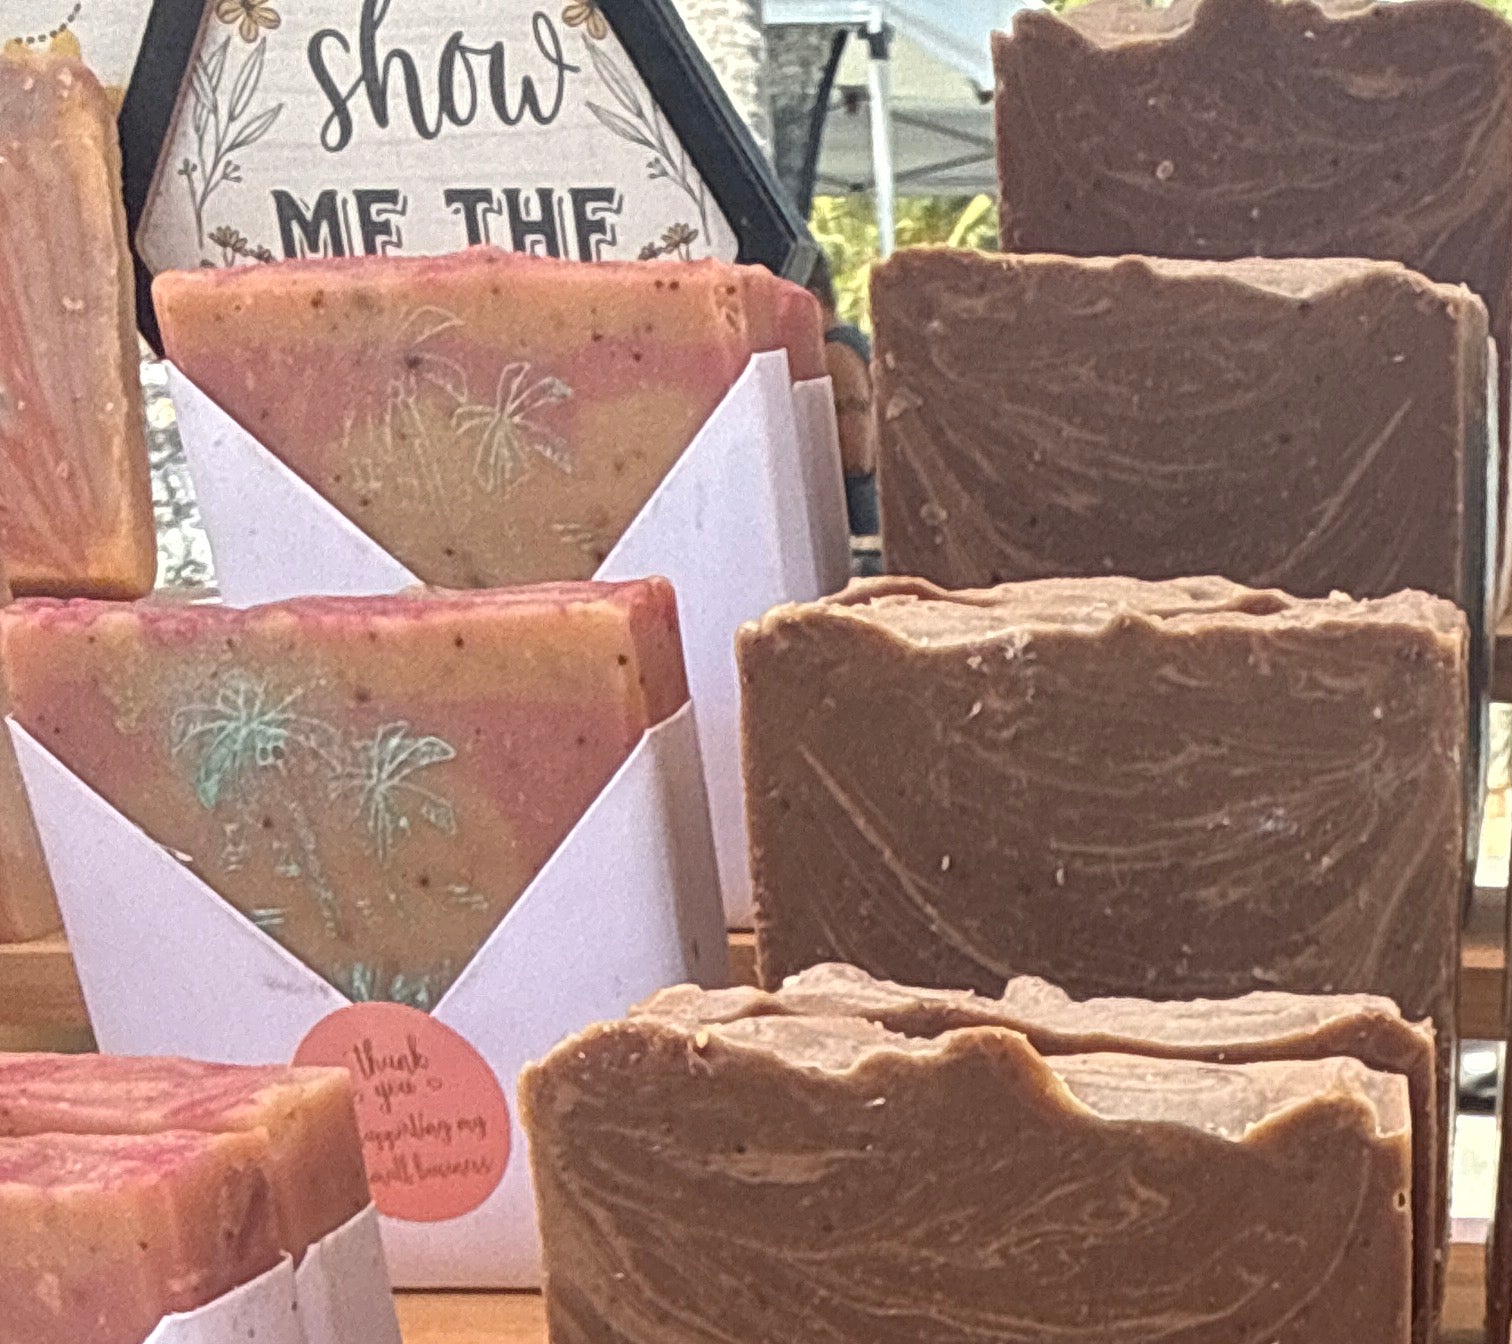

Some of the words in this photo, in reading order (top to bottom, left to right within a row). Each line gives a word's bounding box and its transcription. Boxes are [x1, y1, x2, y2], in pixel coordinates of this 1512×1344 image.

[307, 0, 580, 153] show
[271, 188, 407, 259] ME
[443, 188, 622, 263] THE
[363, 1112, 453, 1152] upporting
